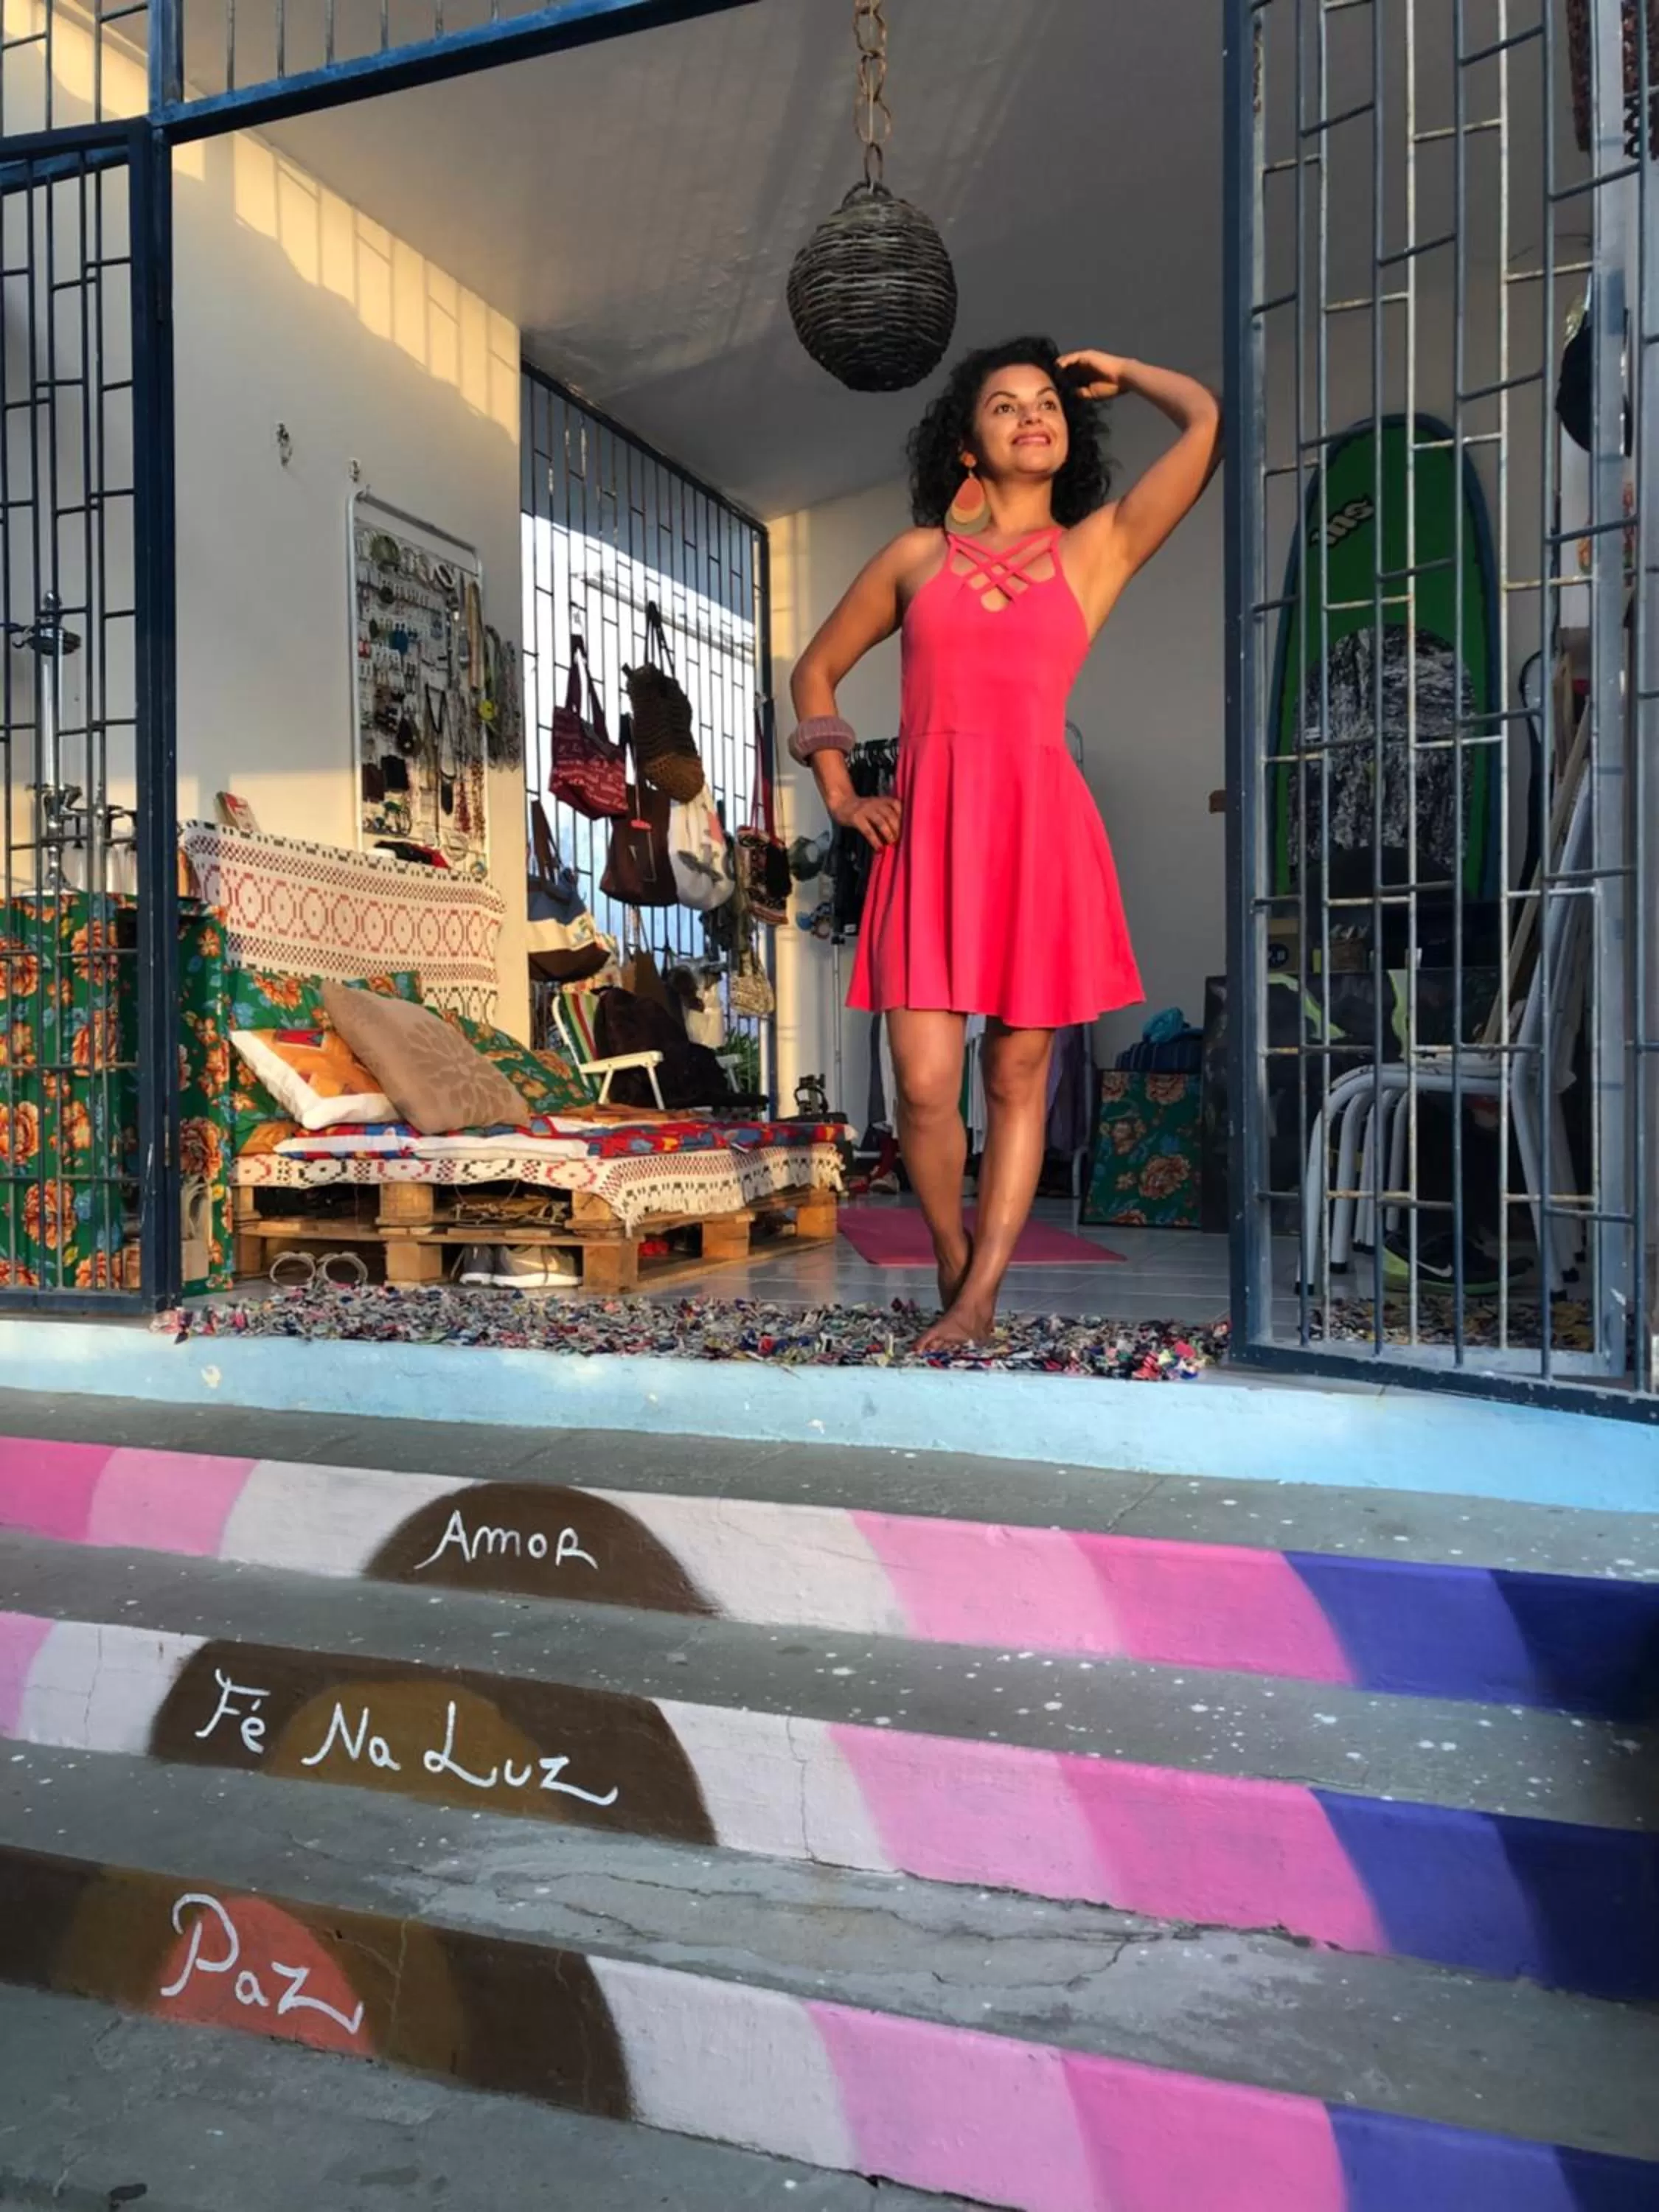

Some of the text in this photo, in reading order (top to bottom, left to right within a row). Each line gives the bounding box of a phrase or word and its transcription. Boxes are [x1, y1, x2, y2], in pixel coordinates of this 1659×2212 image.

[195, 1669, 618, 1806] Fé Na Luz
[160, 1892, 364, 2033] Paz
